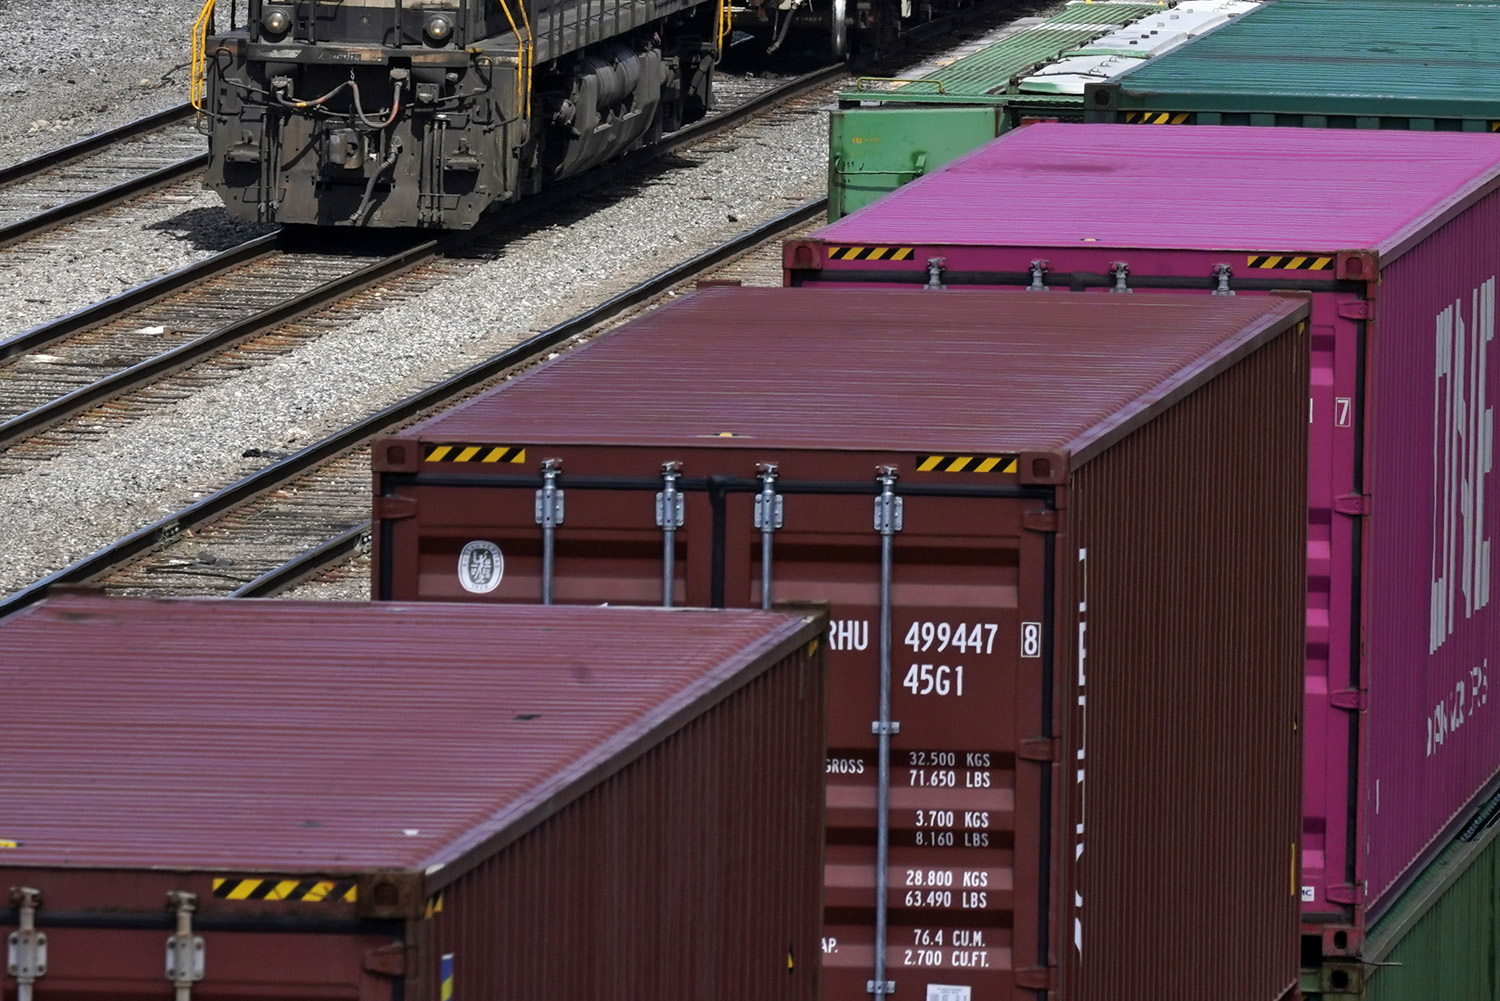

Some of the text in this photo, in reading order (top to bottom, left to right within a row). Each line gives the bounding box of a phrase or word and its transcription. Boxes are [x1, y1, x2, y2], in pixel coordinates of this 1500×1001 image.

[1336, 399, 1349, 425] 7
[1429, 275, 1495, 655] ONE
[828, 620, 1039, 656] RHU 499447 8
[903, 663, 963, 696] 45G1
[825, 758, 865, 774] GROSS
[966, 753, 990, 767] KGS
[966, 771, 990, 788] LBS
[964, 811, 989, 828] KGS
[964, 832, 989, 847] LBS
[963, 871, 988, 887] KGS
[962, 891, 987, 908] LBS
[913, 929, 986, 947] 76.4 CU.M.
[951, 951, 990, 968] CU.FT.
